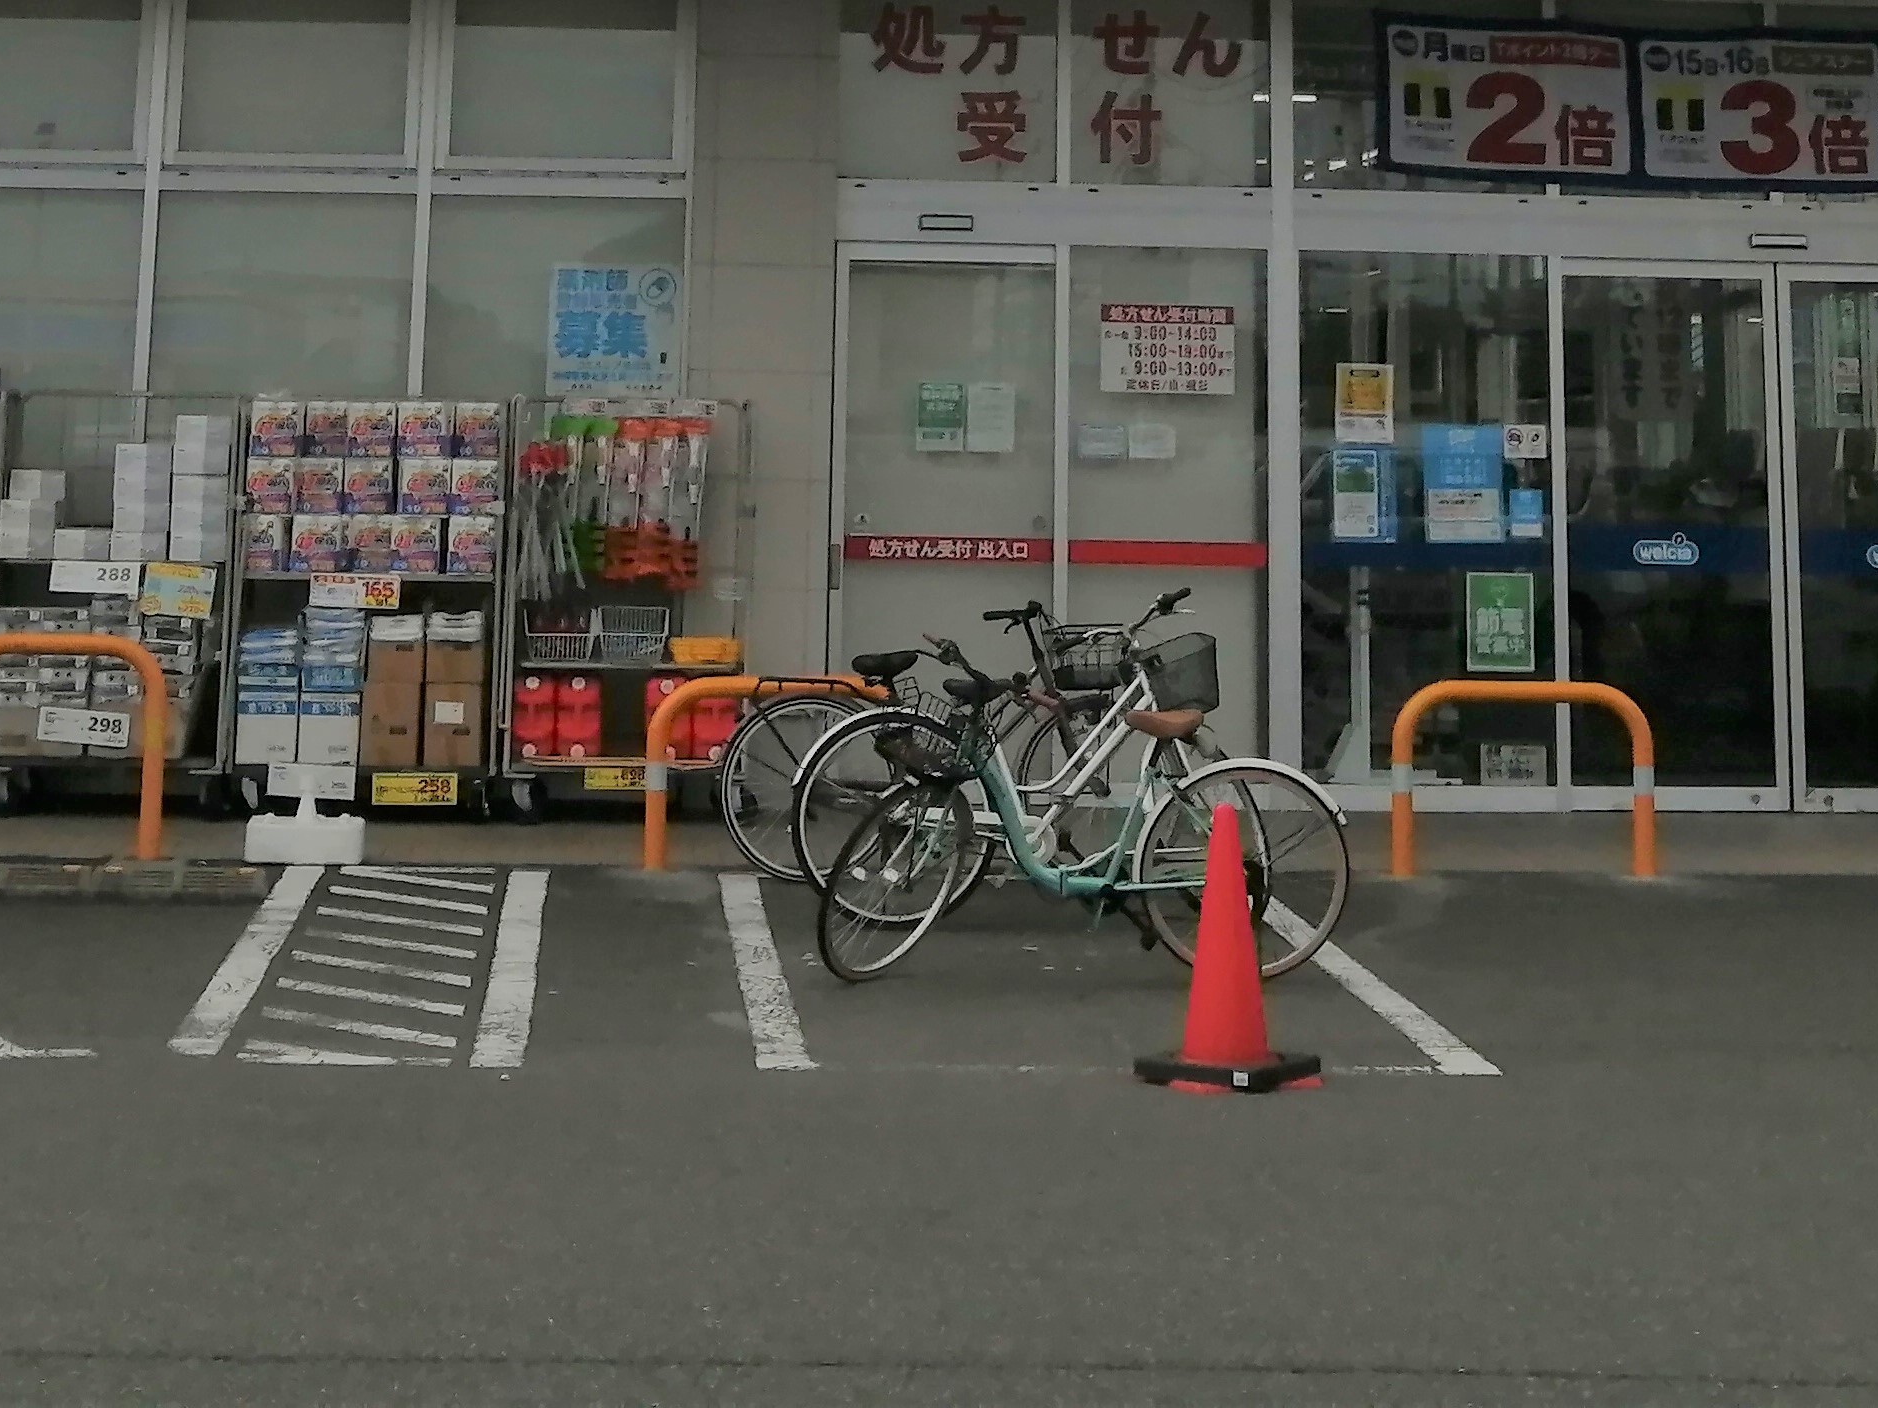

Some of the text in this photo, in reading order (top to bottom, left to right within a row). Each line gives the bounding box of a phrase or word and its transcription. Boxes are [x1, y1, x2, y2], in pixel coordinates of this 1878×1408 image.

[976, 540, 1030, 560] 出入口
[88, 716, 123, 734] 298
